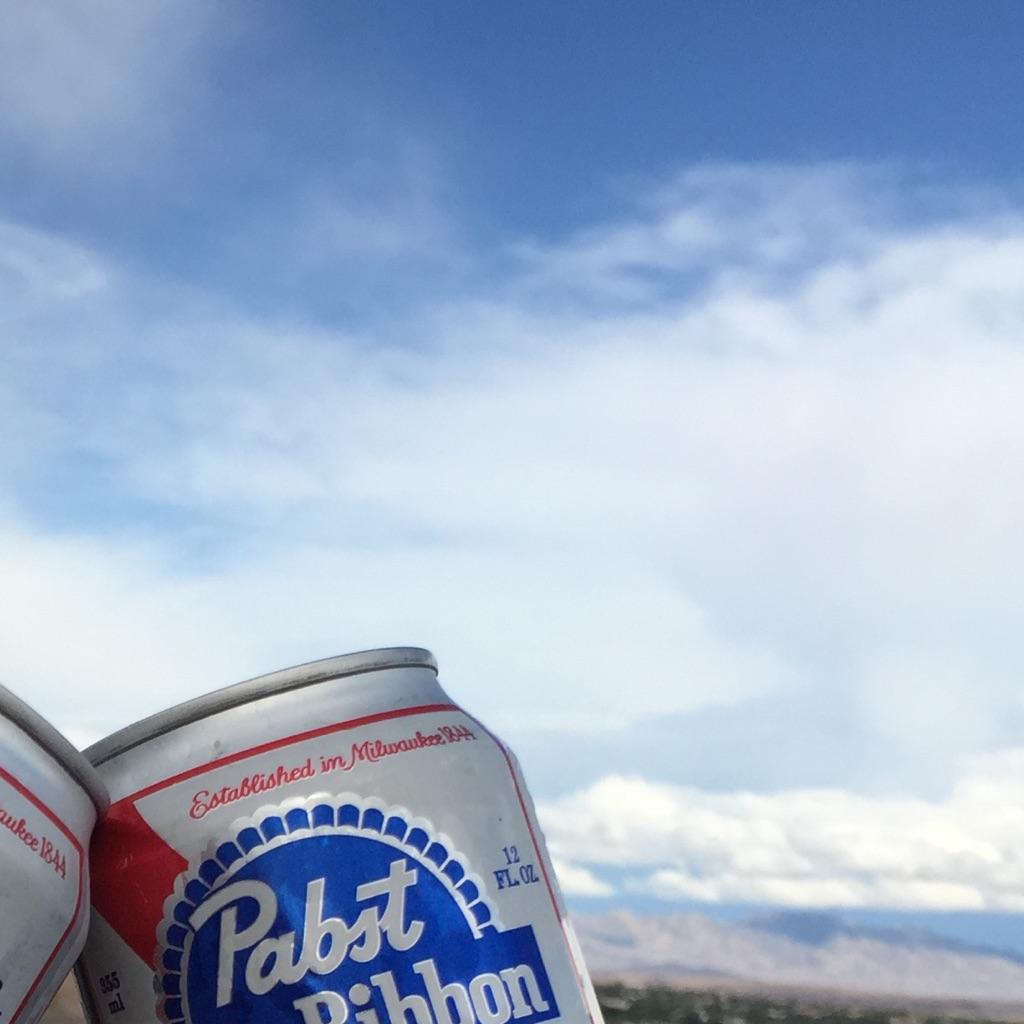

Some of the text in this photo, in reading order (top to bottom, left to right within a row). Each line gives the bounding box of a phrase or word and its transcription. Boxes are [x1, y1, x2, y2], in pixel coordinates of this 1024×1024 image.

[189, 724, 477, 820] Established in Milwaukee 1844
[38, 836, 68, 880] 1844
[502, 846, 520, 864] 12
[189, 858, 425, 1008] Pabst
